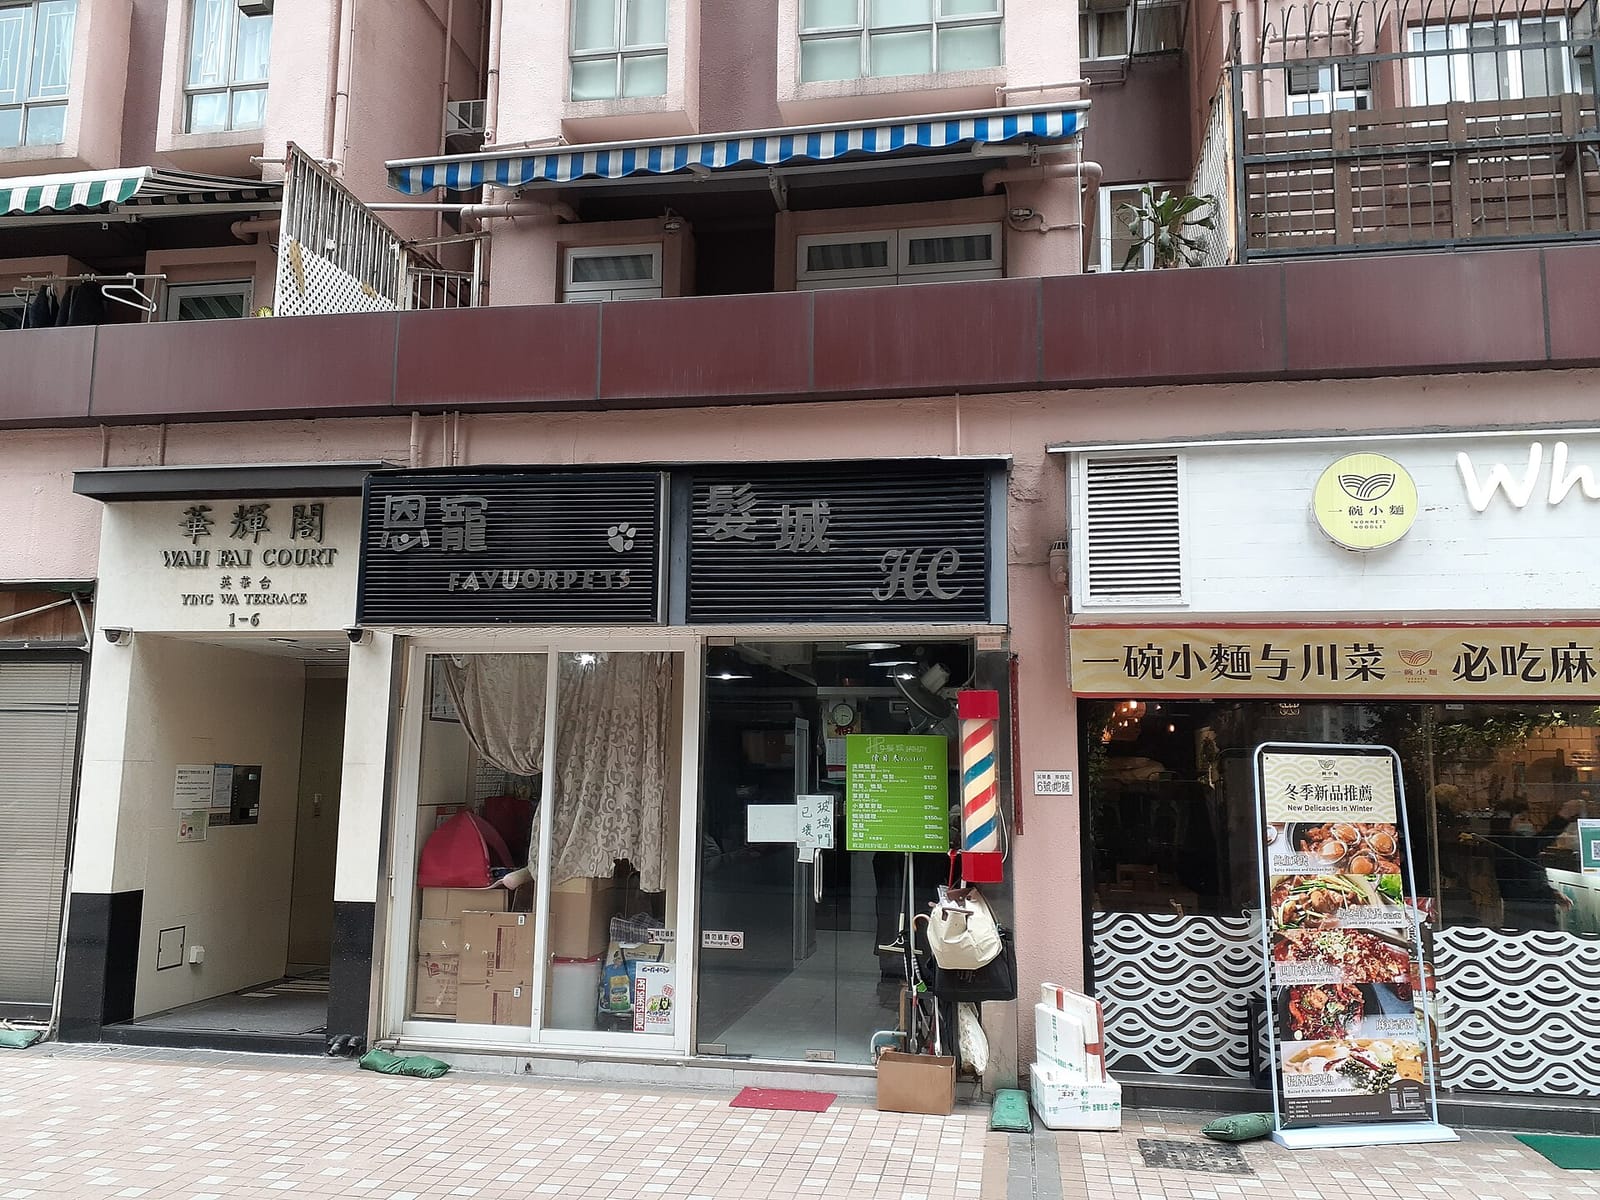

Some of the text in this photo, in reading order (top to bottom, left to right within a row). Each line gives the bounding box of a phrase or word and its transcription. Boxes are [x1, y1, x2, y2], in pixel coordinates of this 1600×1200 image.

[706, 482, 830, 553] 髮城
[1327, 504, 1404, 516] 一碗小麵
[179, 503, 325, 544] 華輝閣
[380, 495, 488, 551] 恩寵
[160, 548, 338, 568] WAH FAI COURT
[220, 575, 272, 590] 英華台
[448, 569, 630, 591] FAVUORPETS
[181, 592, 308, 606] YING WA TERRACE
[229, 612, 260, 627] 1-6
[1082, 641, 1386, 682] 一碗小麵与川菜
[1452, 641, 1598, 683] 必吃麻
[1284, 783, 1373, 802] 冬季新品推薦
[1287, 804, 1302, 812] New
[1304, 804, 1340, 812] Delicacies
